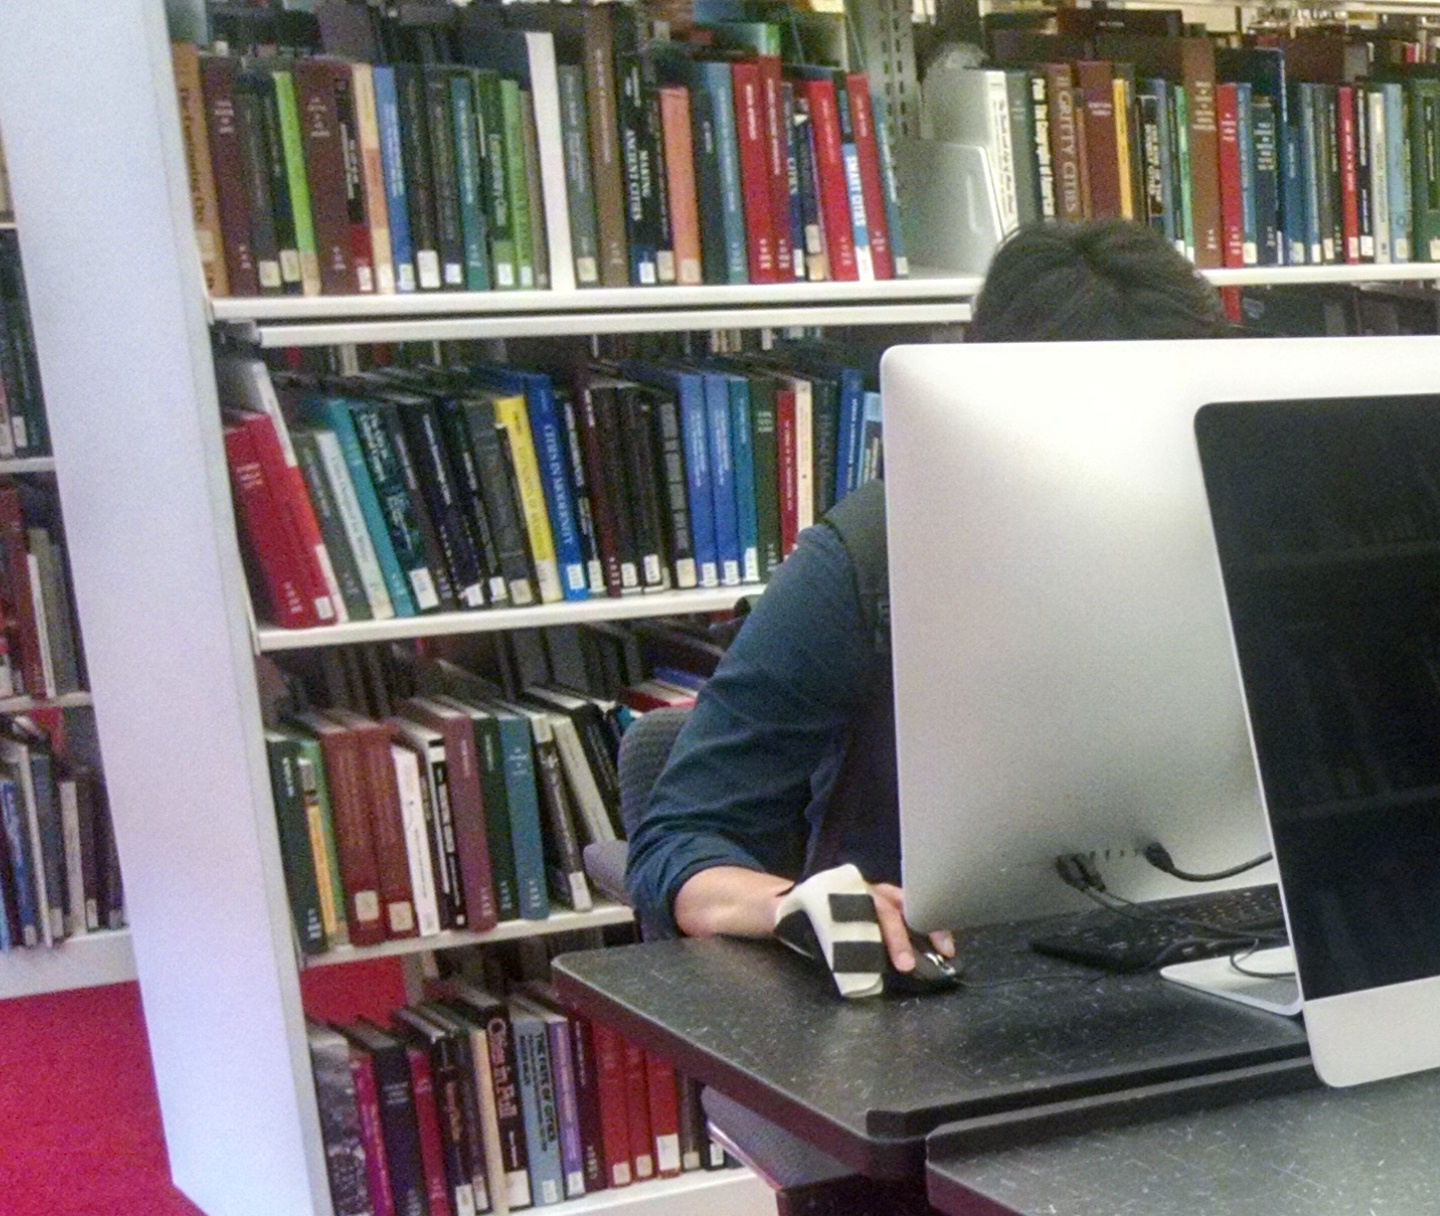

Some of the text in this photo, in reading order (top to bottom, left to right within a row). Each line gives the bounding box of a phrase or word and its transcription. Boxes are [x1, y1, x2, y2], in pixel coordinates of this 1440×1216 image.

[625, 128, 642, 221] ANCIENT CITIES
[787, 157, 798, 195] CITIES
[1057, 91, 1078, 213] GRITTY CITIES
[846, 155, 866, 227] SMART CITIES
[549, 461, 561, 475] IN
